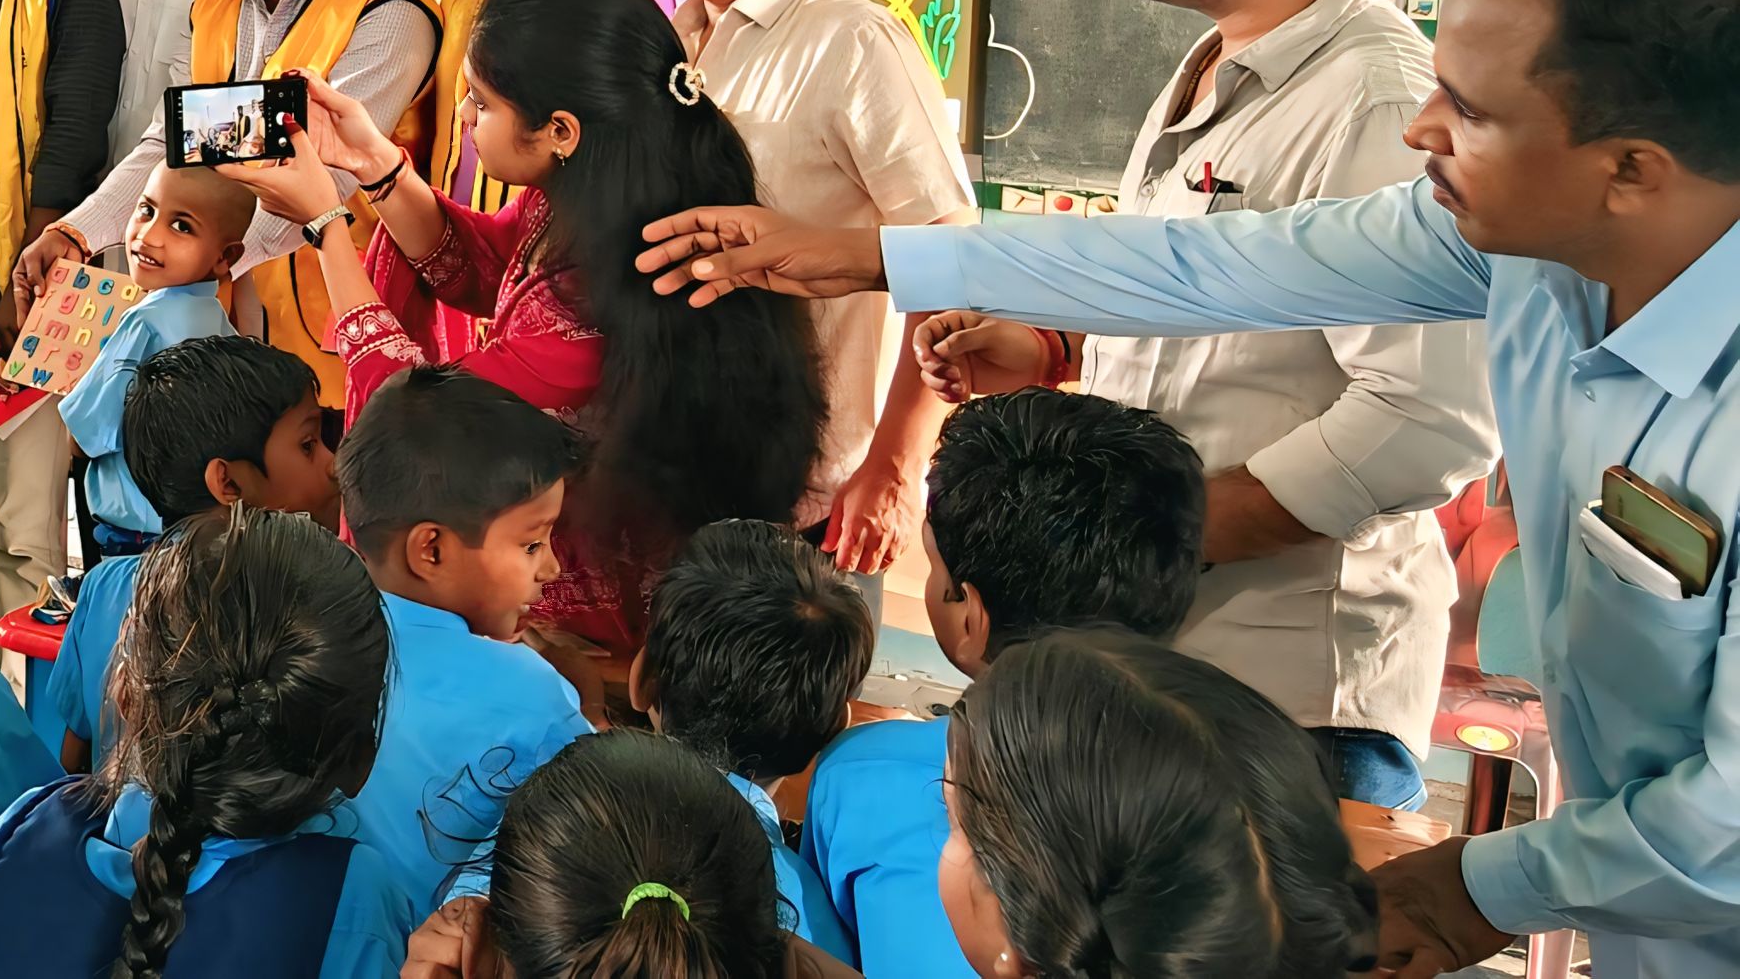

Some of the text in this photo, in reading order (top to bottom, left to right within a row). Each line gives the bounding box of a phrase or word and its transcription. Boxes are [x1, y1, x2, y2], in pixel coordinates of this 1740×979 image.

[72, 267, 91, 290] b
[59, 290, 80, 315] g
[79, 297, 98, 321] h
[44, 320, 71, 341] m
[73, 327, 93, 347] n
